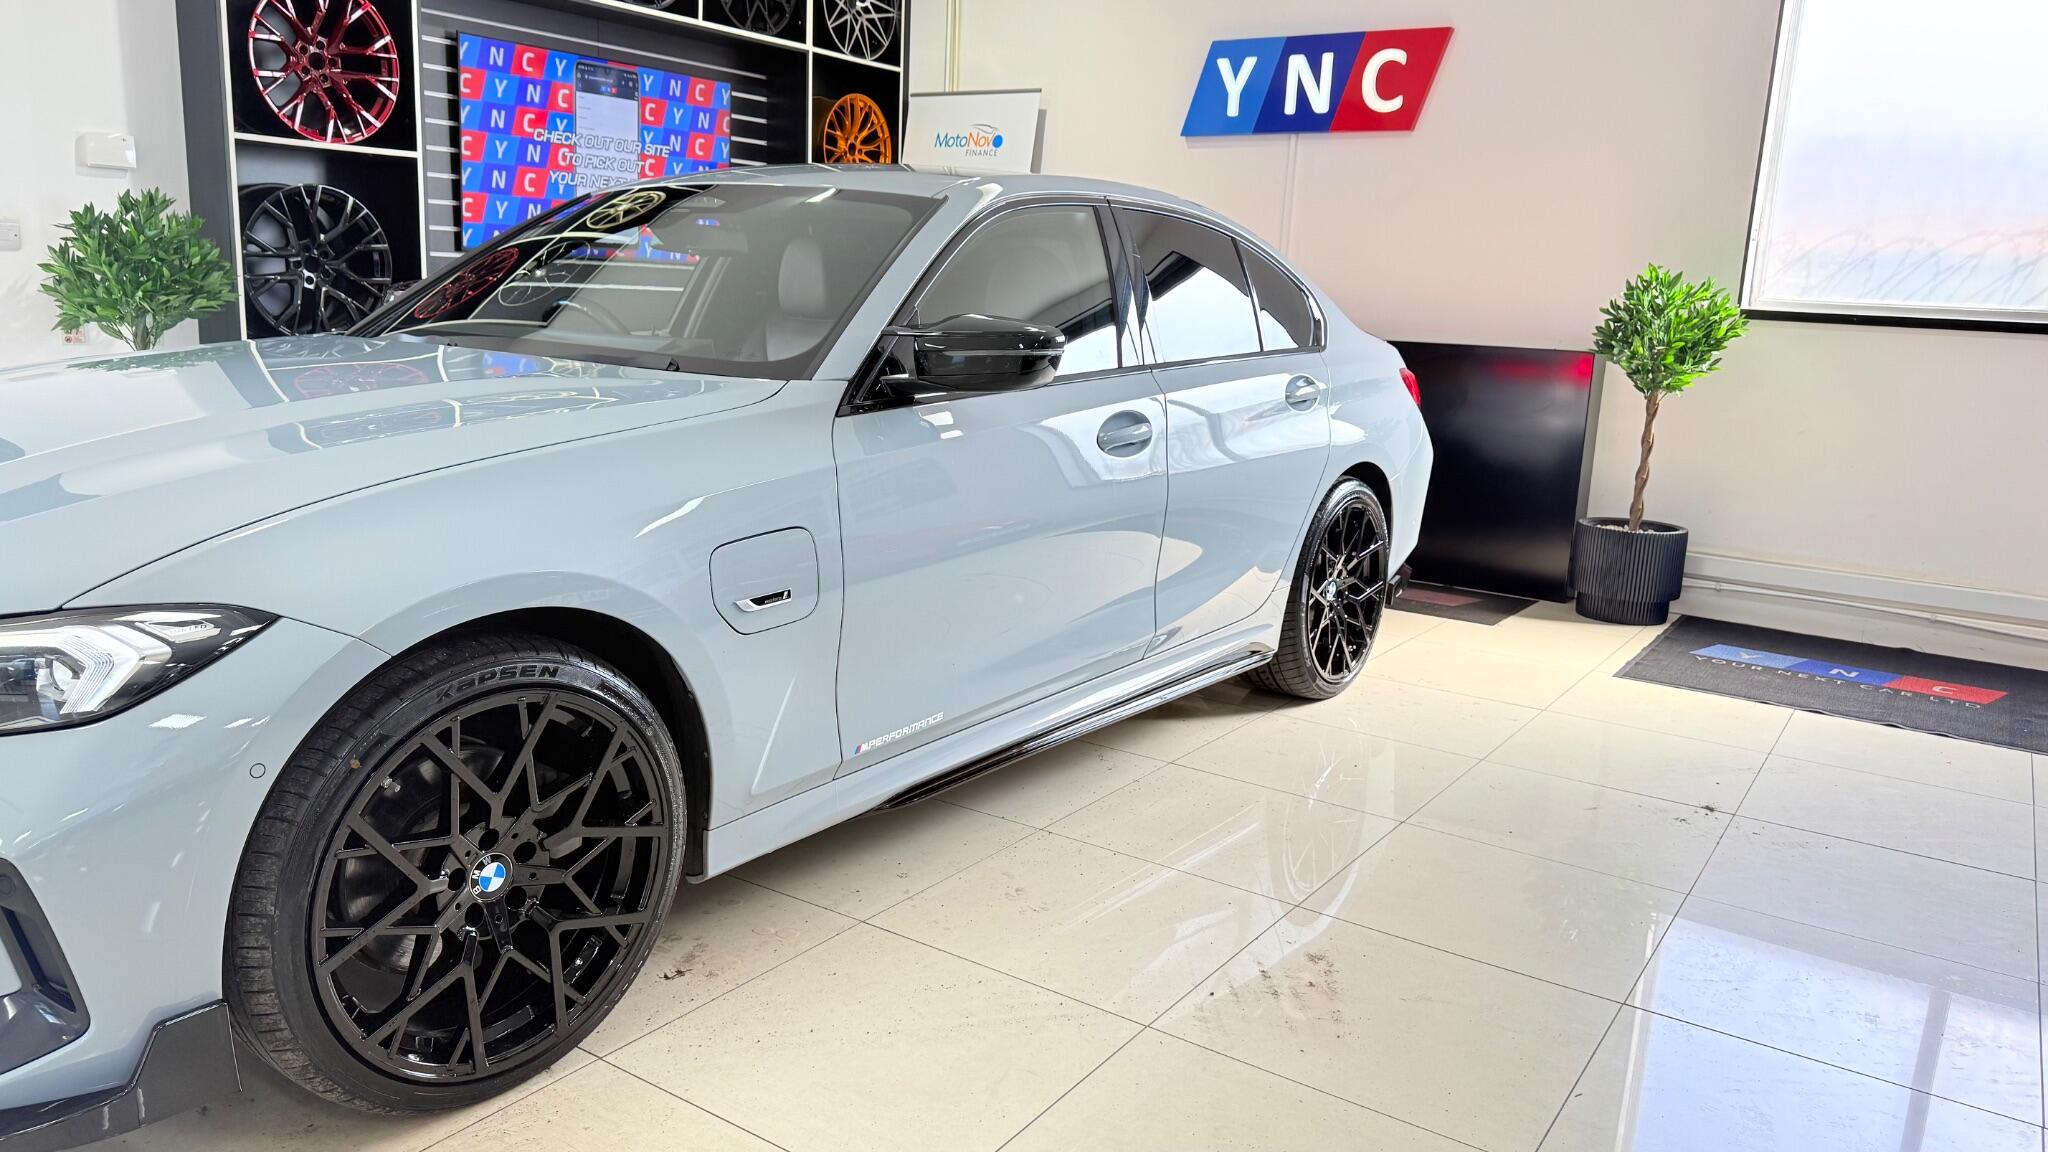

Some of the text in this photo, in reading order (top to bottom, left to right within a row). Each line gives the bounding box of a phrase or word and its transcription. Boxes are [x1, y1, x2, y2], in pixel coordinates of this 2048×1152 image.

[1216, 47, 1408, 118] YNC
[533, 128, 672, 158] CHECK OUT OUR SITE
[965, 148, 999, 157] FINANCE
[564, 152, 645, 174] TO PICK OUT
[549, 170, 589, 188] YOUR
[1695, 655, 1981, 709] YOUR NEXT CAR LTD
